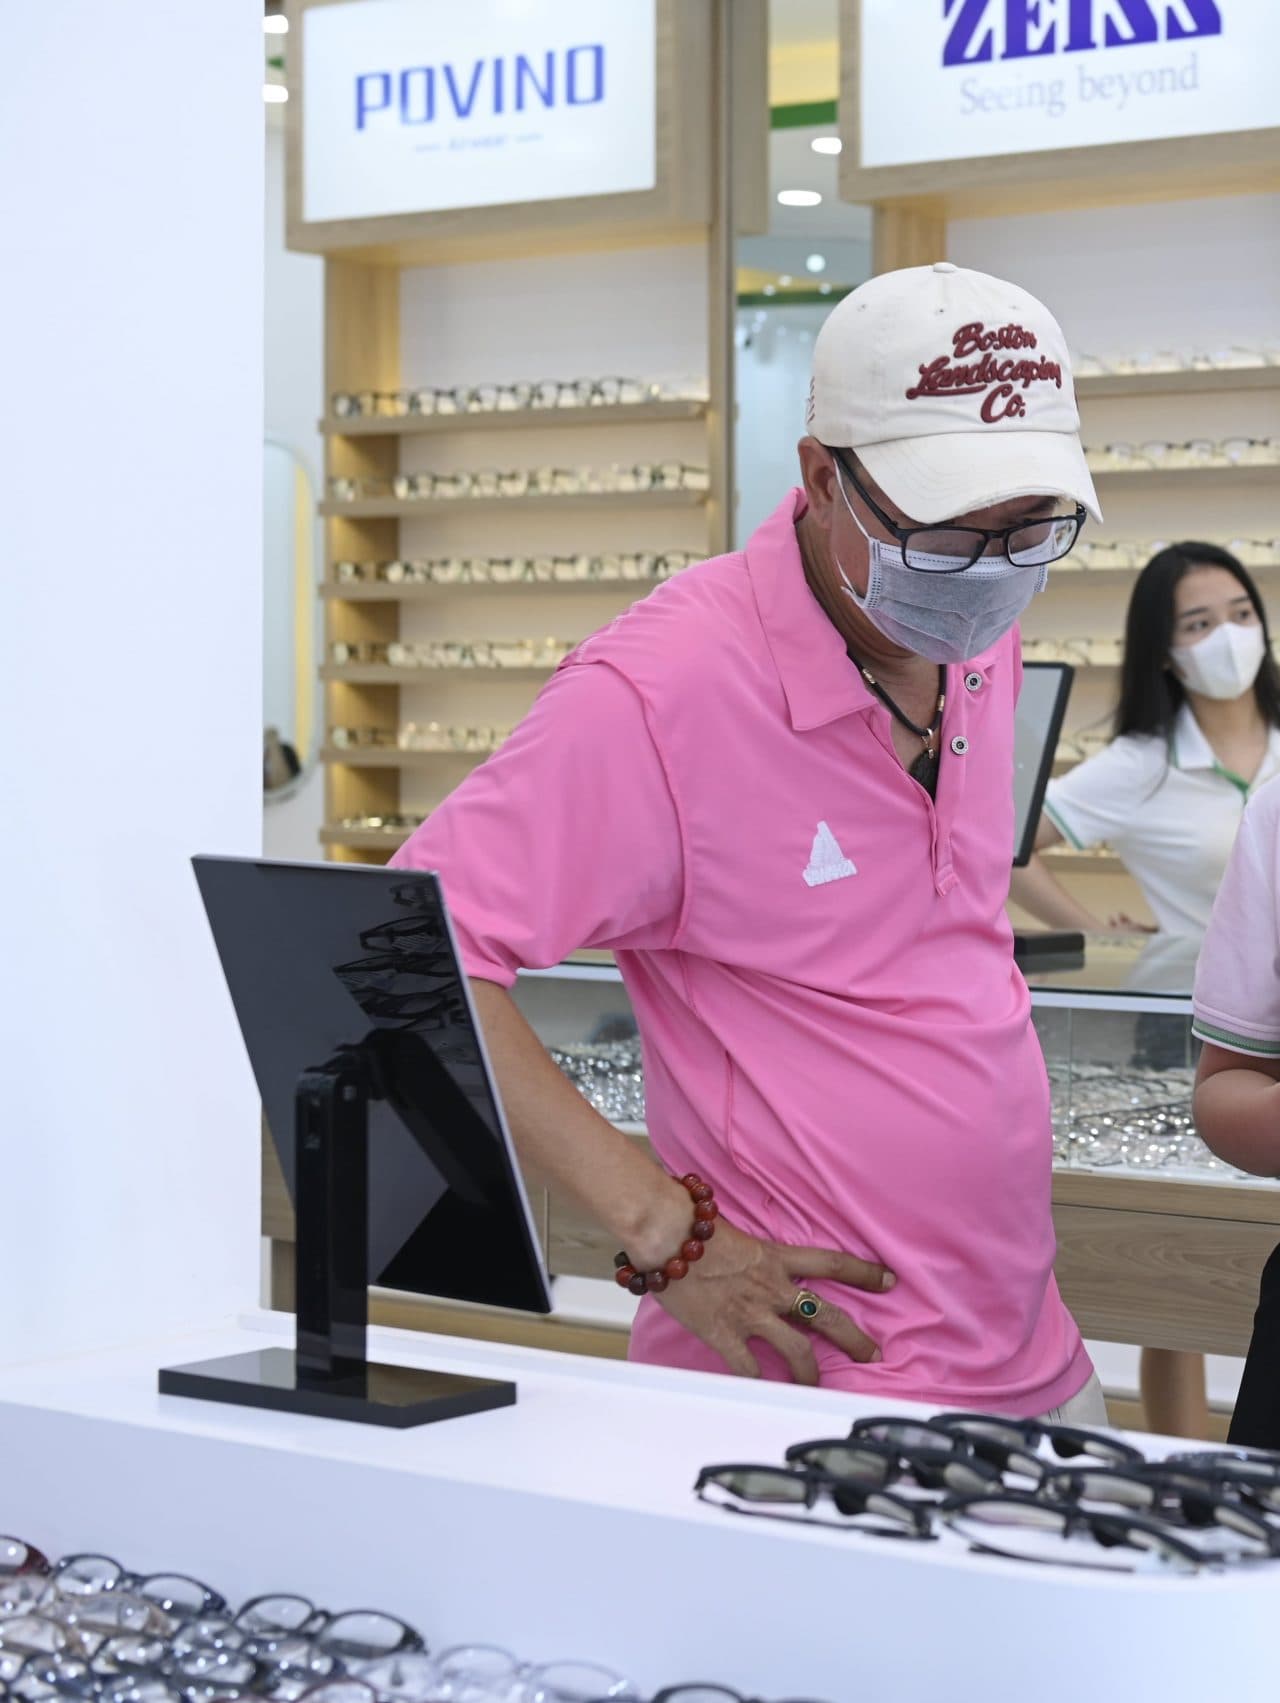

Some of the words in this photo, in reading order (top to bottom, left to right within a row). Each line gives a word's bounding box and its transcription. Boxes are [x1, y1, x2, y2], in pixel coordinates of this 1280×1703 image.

[355, 44, 604, 131] POVINO
[959, 76, 1066, 118] Seeing
[1076, 51, 1199, 110] beyond
[952, 321, 1038, 359] Boston
[981, 384, 1025, 423] Co.
